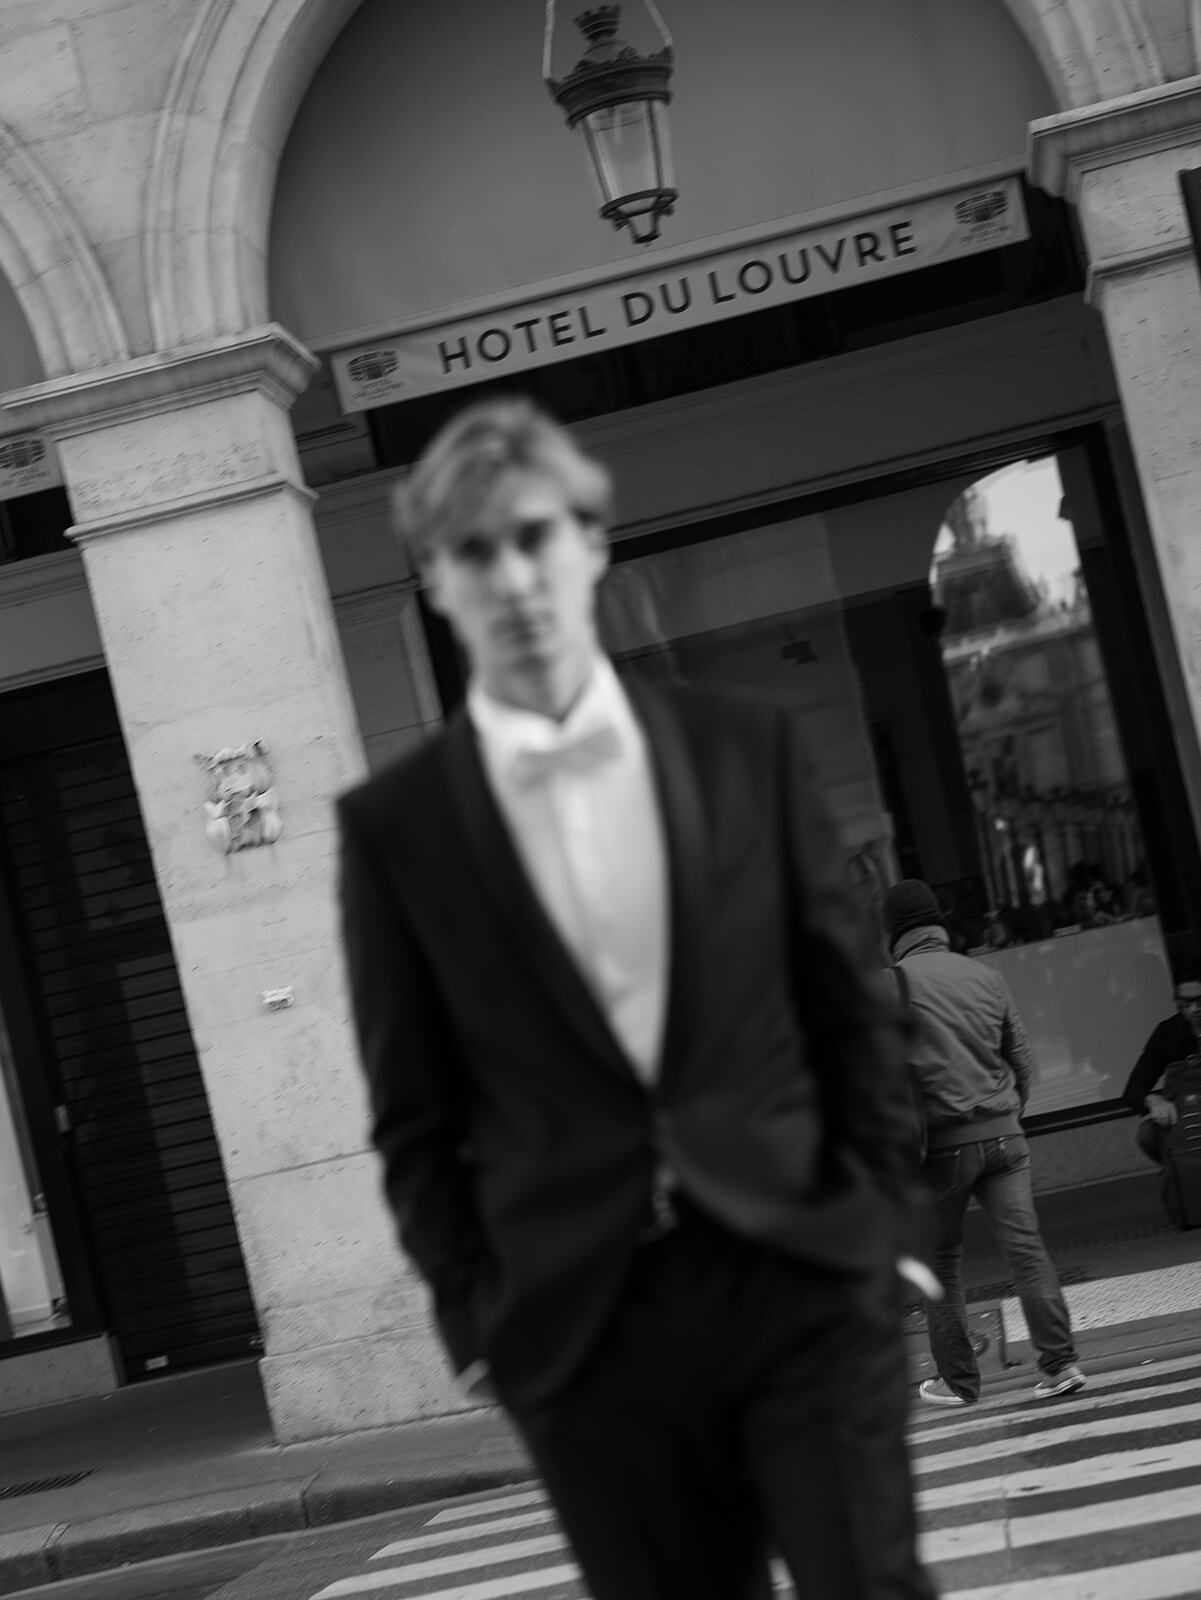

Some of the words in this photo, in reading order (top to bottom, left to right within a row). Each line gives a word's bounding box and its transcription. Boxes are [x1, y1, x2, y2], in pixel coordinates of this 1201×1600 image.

[438, 306, 606, 374] HOTEL
[621, 278, 692, 327] DU
[708, 220, 917, 304] LOUVRE
